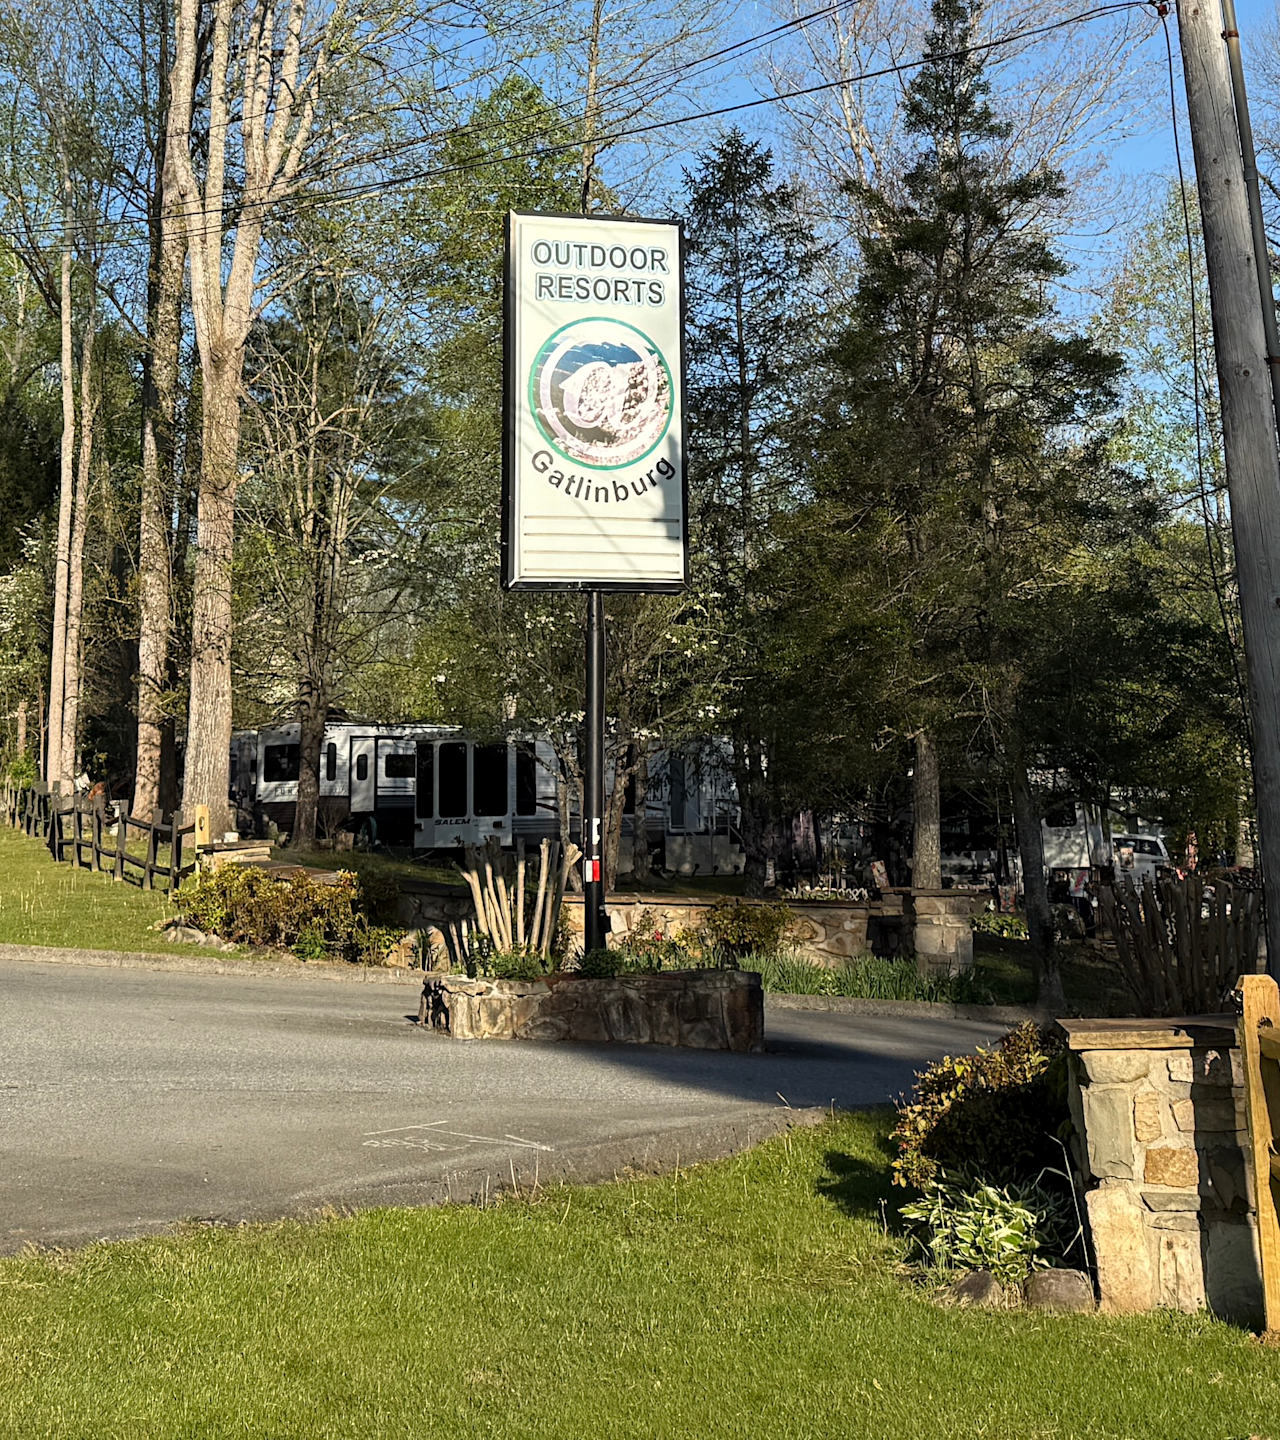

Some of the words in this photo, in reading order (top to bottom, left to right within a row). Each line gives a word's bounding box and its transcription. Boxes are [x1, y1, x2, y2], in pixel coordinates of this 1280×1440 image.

[533, 242, 668, 272] OUTDOOR
[537, 276, 664, 304] RESORTS
[531, 449, 676, 503] Gatlinburg
[434, 818, 471, 826] SALEM
